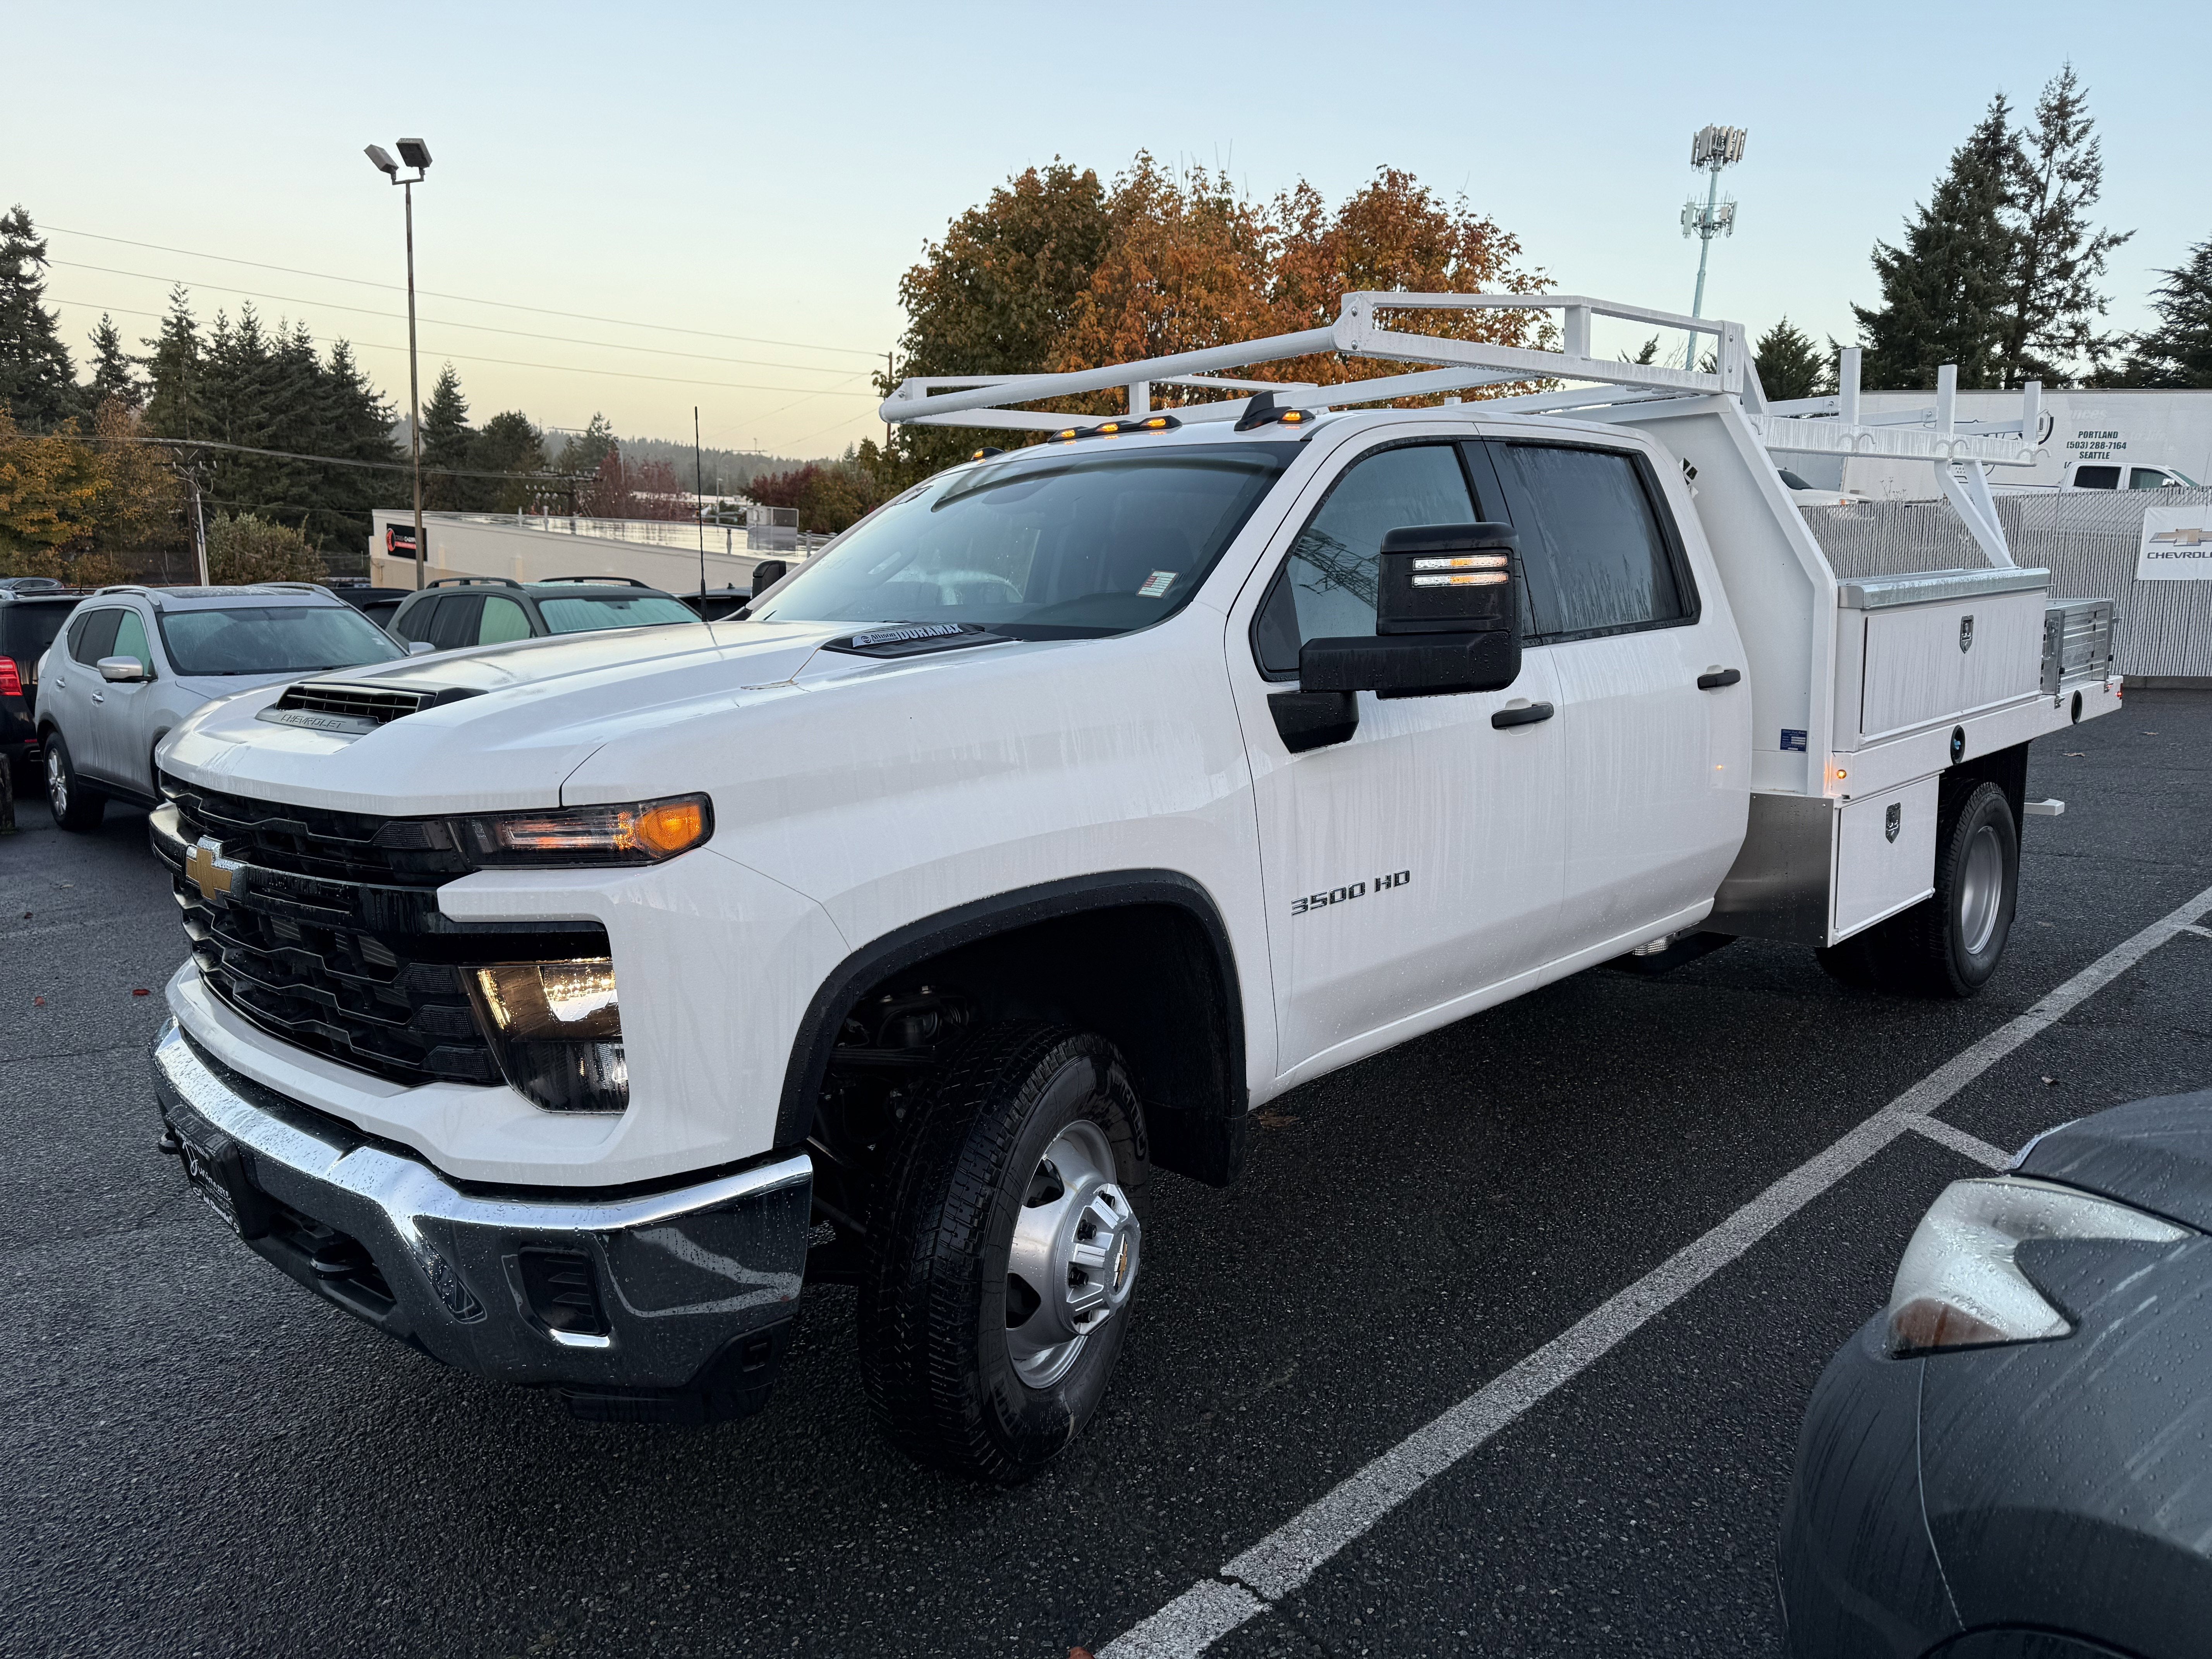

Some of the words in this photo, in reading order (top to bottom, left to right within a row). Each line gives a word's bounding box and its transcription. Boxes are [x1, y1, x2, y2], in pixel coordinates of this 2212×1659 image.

[2079, 451, 2110, 459] SEATTLE
[898, 623, 963, 640] DURAMAX
[281, 714, 346, 728] CHEVROLET
[1291, 881, 1365, 916] 3500
[1374, 869, 1410, 893] HD
